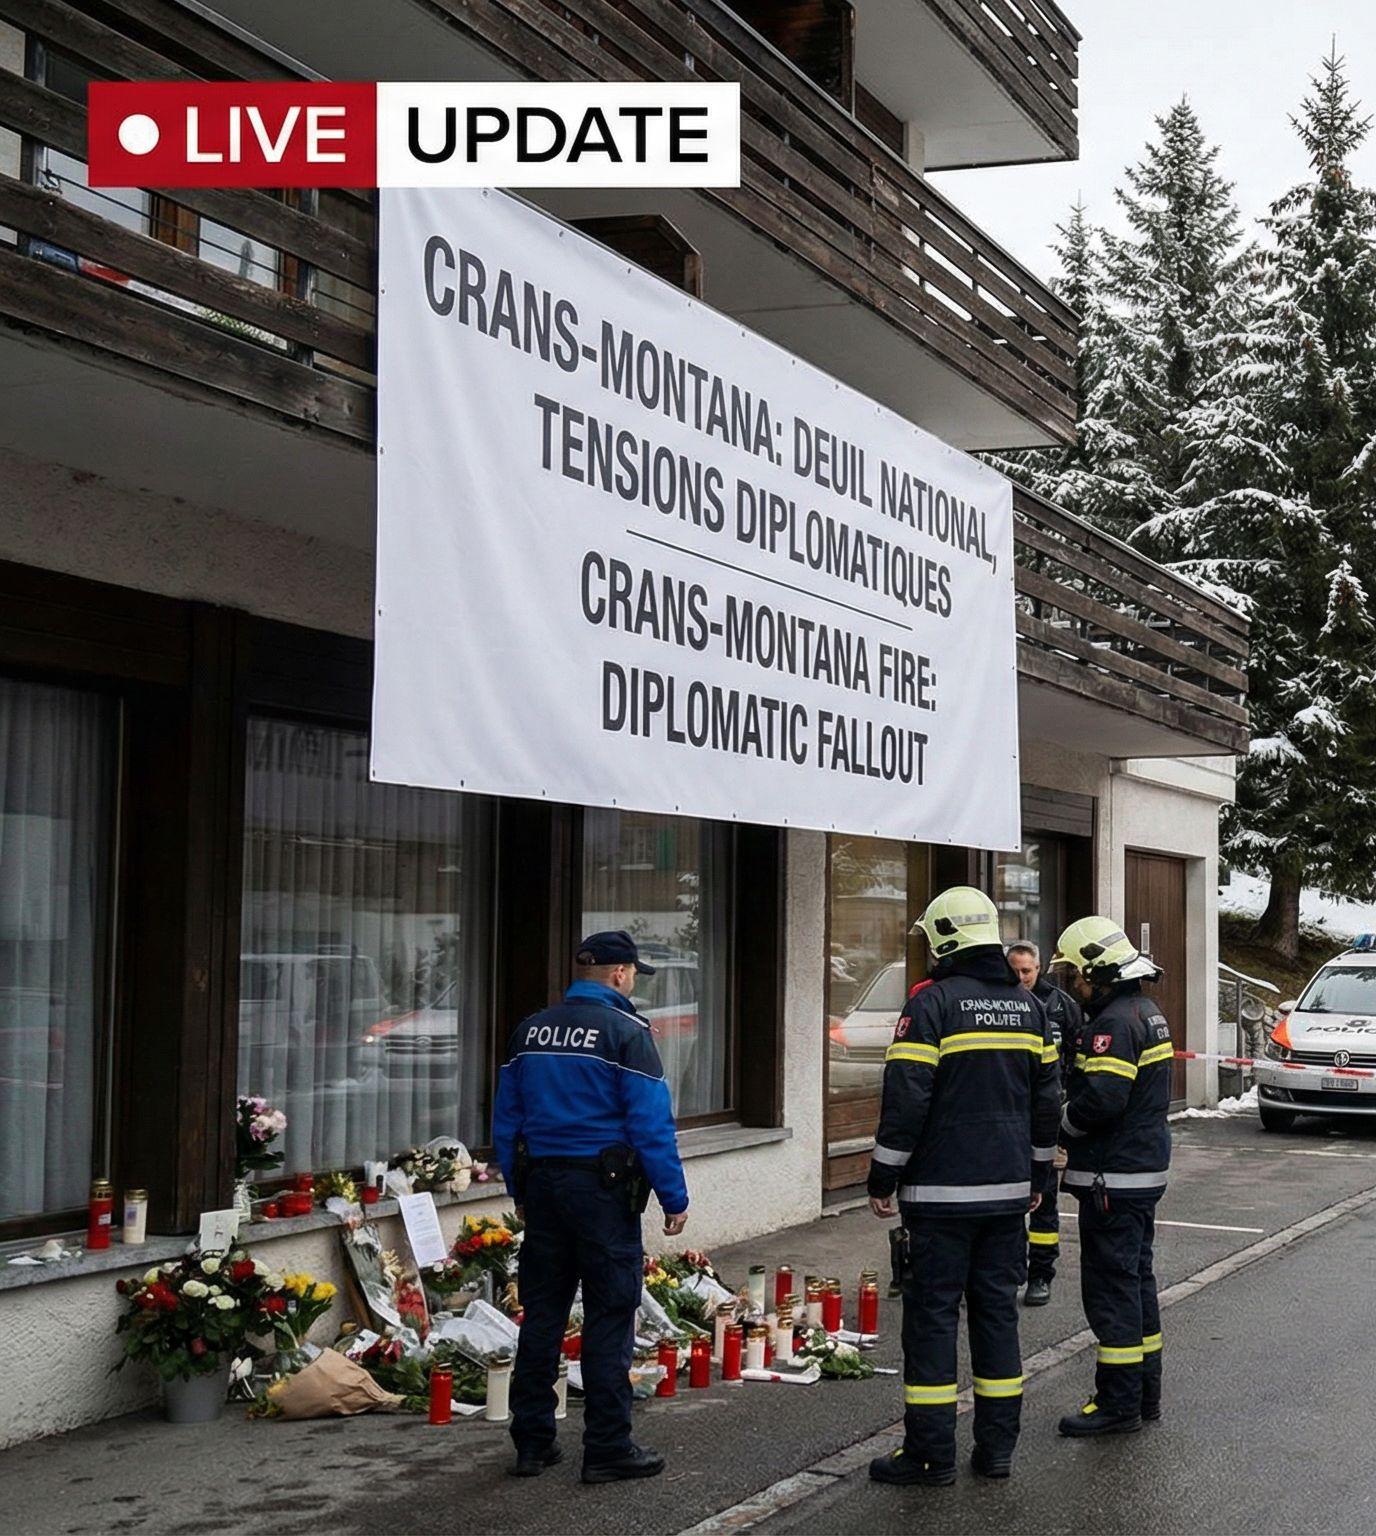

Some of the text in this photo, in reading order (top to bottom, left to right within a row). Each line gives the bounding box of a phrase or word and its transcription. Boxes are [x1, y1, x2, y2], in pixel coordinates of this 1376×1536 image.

[424, 235, 997, 575] CRANS-MONTANA: DEUIL NATIONAL,
[534, 393, 951, 618] TENSIONS DIPLOMATIQUES
[581, 551, 937, 712] CRANS-MONTANA FIRE:
[603, 661, 929, 785] DIPLOMATIC FALLOUT
[525, 1026, 599, 1048] POLICE
